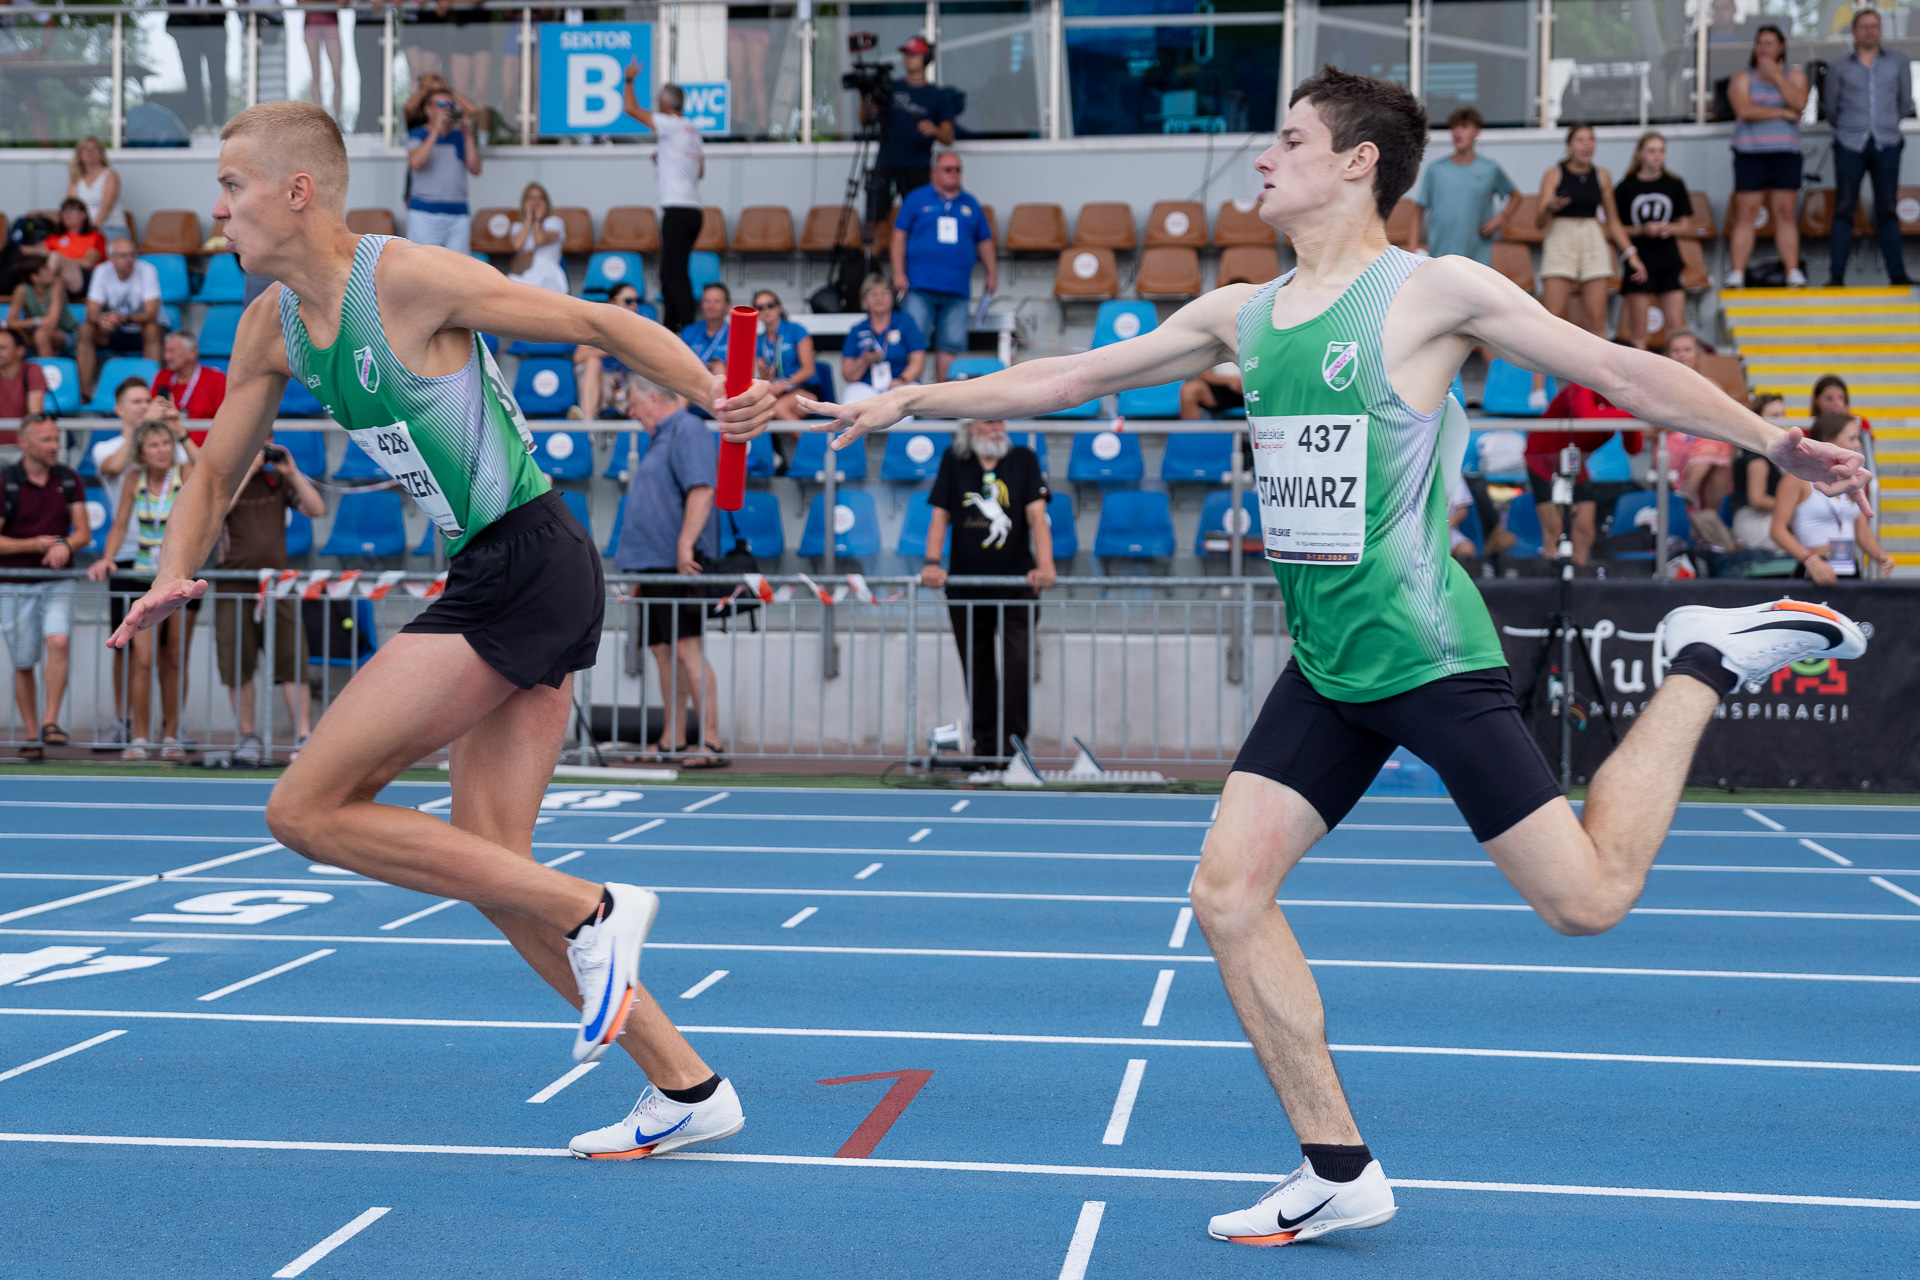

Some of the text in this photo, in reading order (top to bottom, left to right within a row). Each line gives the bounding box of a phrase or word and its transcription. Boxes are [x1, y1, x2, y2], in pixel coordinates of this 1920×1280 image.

[560, 30, 632, 49] SEKTOR
[566, 53, 624, 128] B
[682, 87, 725, 115] WC
[376, 432, 410, 455] 428
[1298, 424, 1352, 453] 437
[1713, 702, 1849, 724] NSPIRACJI
[130, 889, 335, 925] 5
